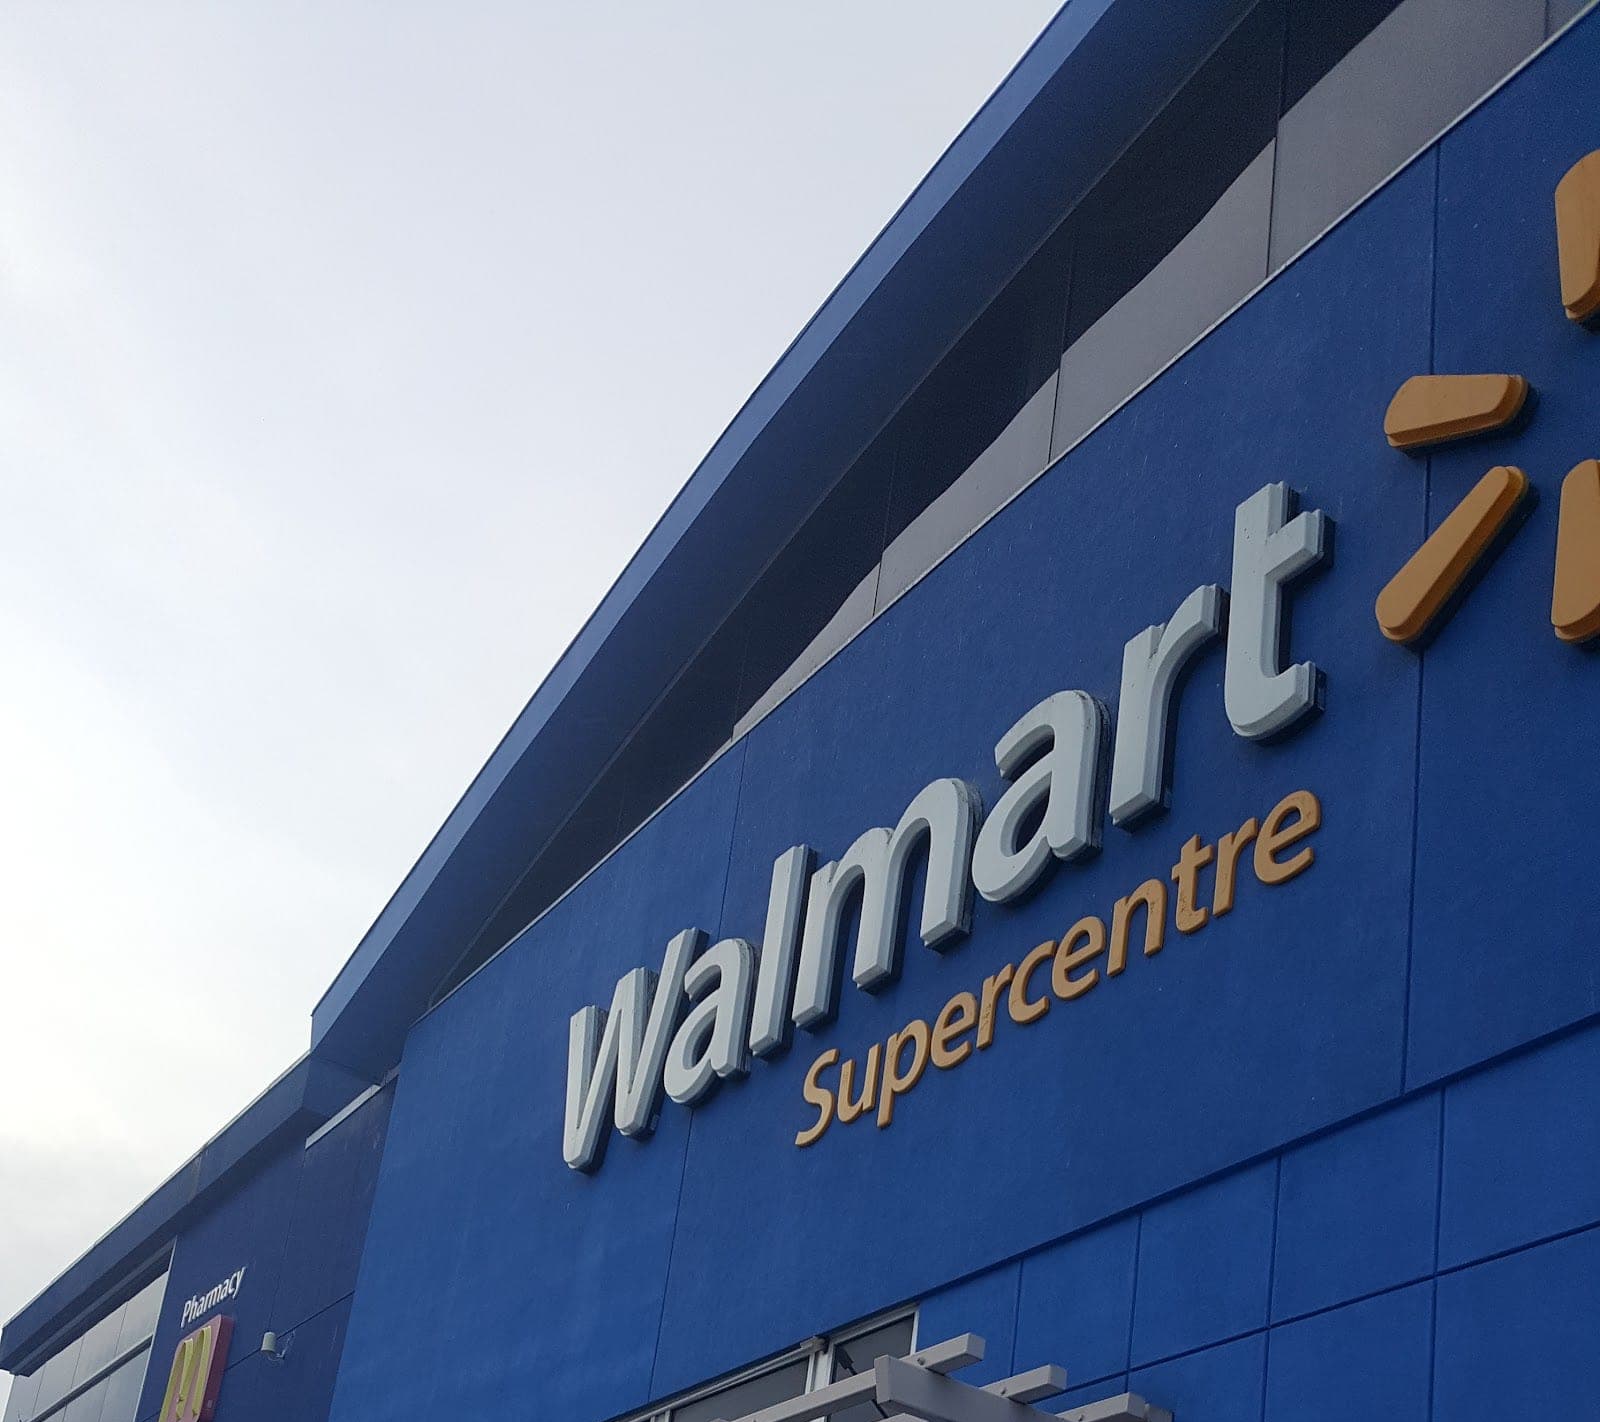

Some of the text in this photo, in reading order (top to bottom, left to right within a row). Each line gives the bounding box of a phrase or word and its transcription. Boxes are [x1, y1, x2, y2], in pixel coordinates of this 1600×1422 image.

[562, 481, 1334, 1172] Walmart
[795, 789, 1322, 1148] Supercentre
[180, 1265, 248, 1329] Pharmacy
